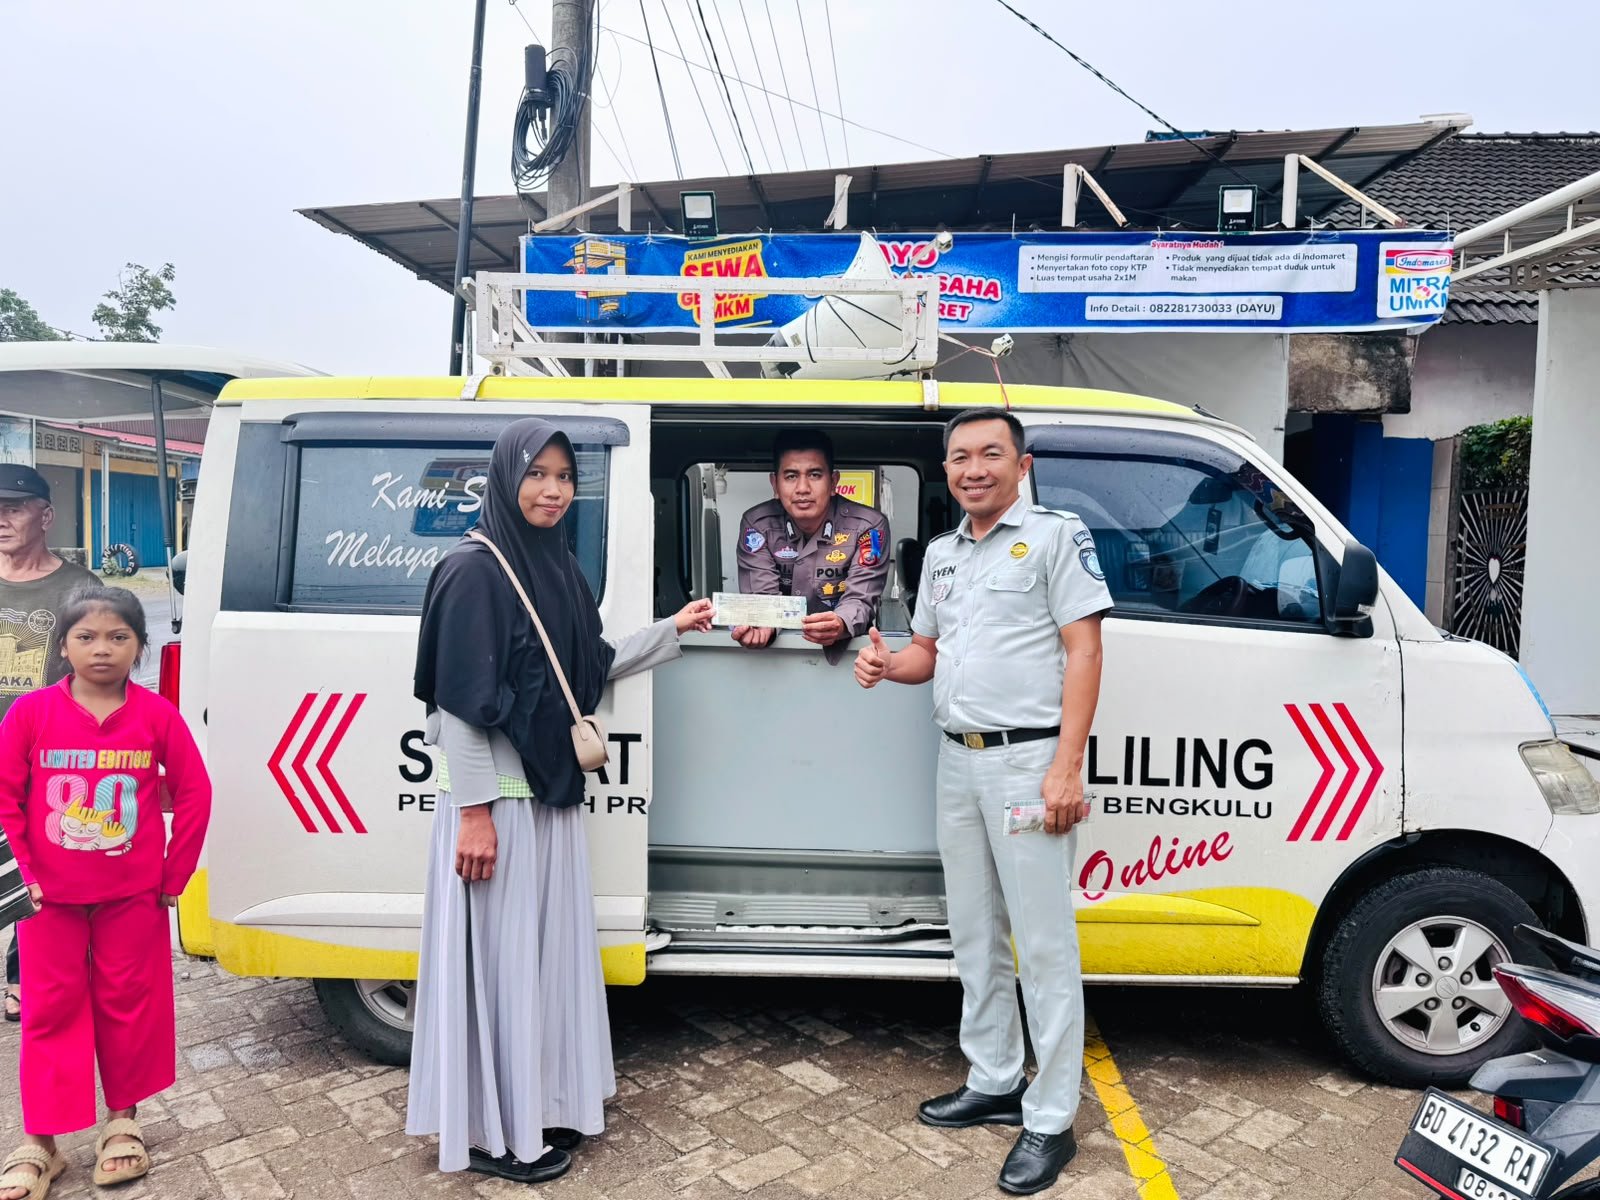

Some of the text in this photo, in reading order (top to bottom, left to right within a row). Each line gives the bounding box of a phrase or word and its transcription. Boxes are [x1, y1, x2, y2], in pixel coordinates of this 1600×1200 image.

[1151, 241, 1191, 249] Syaratnya
[688, 242, 759, 261] KAMI MENYEDIAKAN
[1037, 253, 1155, 262] Mengisi formulir pendaftaran
[1172, 252, 1346, 263] Produk yang dijual tidak ada di Indomaret
[1399, 256, 1448, 267] Indomaret
[1037, 263, 1148, 273] Menyertakan foto copy KTP
[1172, 263, 1336, 273] Tidak menyediakan tempat duduk untuk
[1036, 273, 1137, 283] Luas tempat usaha 2x1M
[1171, 274, 1197, 282] makan
[1390, 276, 1451, 294] MITRA
[1090, 304, 1109, 313] Info
[1111, 304, 1140, 313] Detail
[1149, 304, 1232, 314] 082281730033
[1236, 303, 1275, 315] (DAYU)
[371, 471, 450, 512] Kami
[325, 529, 447, 579] Melaya
[0, 676, 33, 688] AKA
[40, 749, 152, 769] LIMITED EDITION
[1087, 735, 1273, 790] LILING
[1103, 796, 1273, 819] BENGKULU
[1078, 831, 1234, 901] Online
[1420, 1101, 1537, 1187] BD 4132 RA
